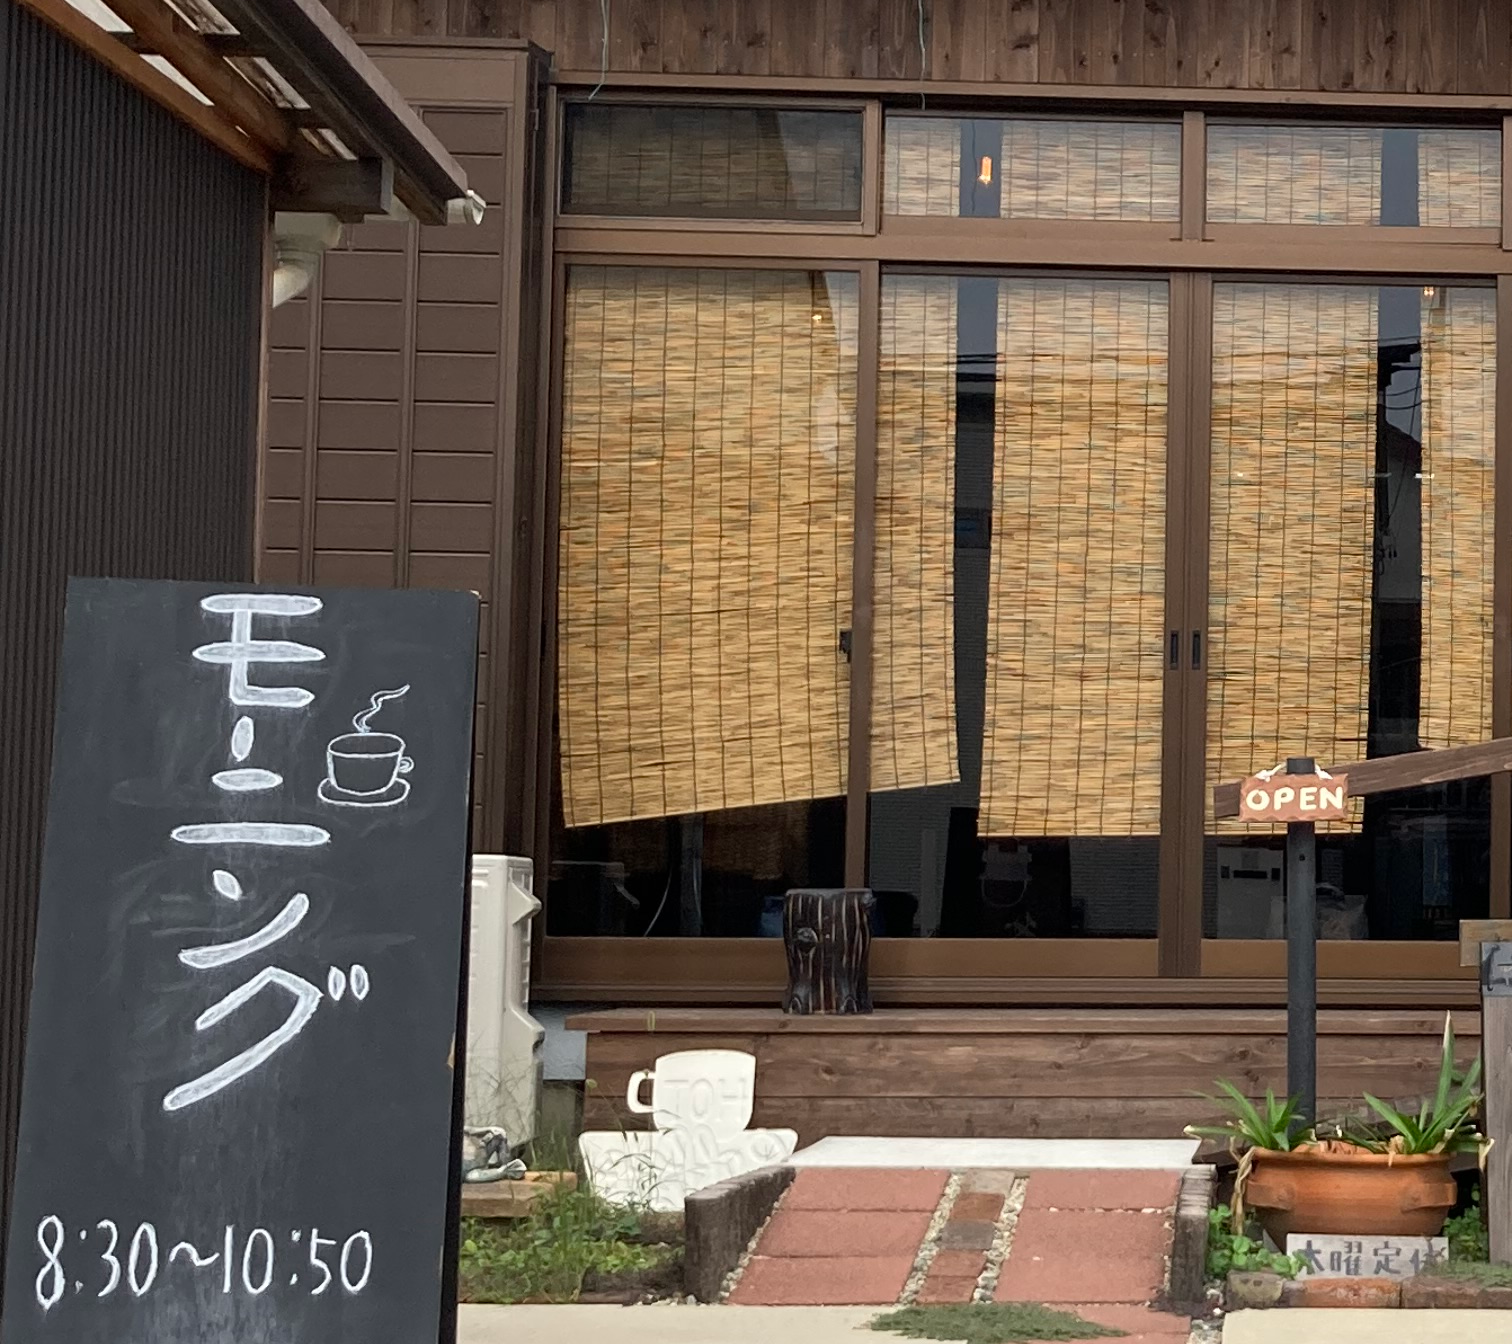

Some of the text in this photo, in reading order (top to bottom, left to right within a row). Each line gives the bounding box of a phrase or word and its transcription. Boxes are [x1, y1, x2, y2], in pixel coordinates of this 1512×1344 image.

[163, 593, 370, 1111] モーニング
[1245, 786, 1344, 811] OPEN
